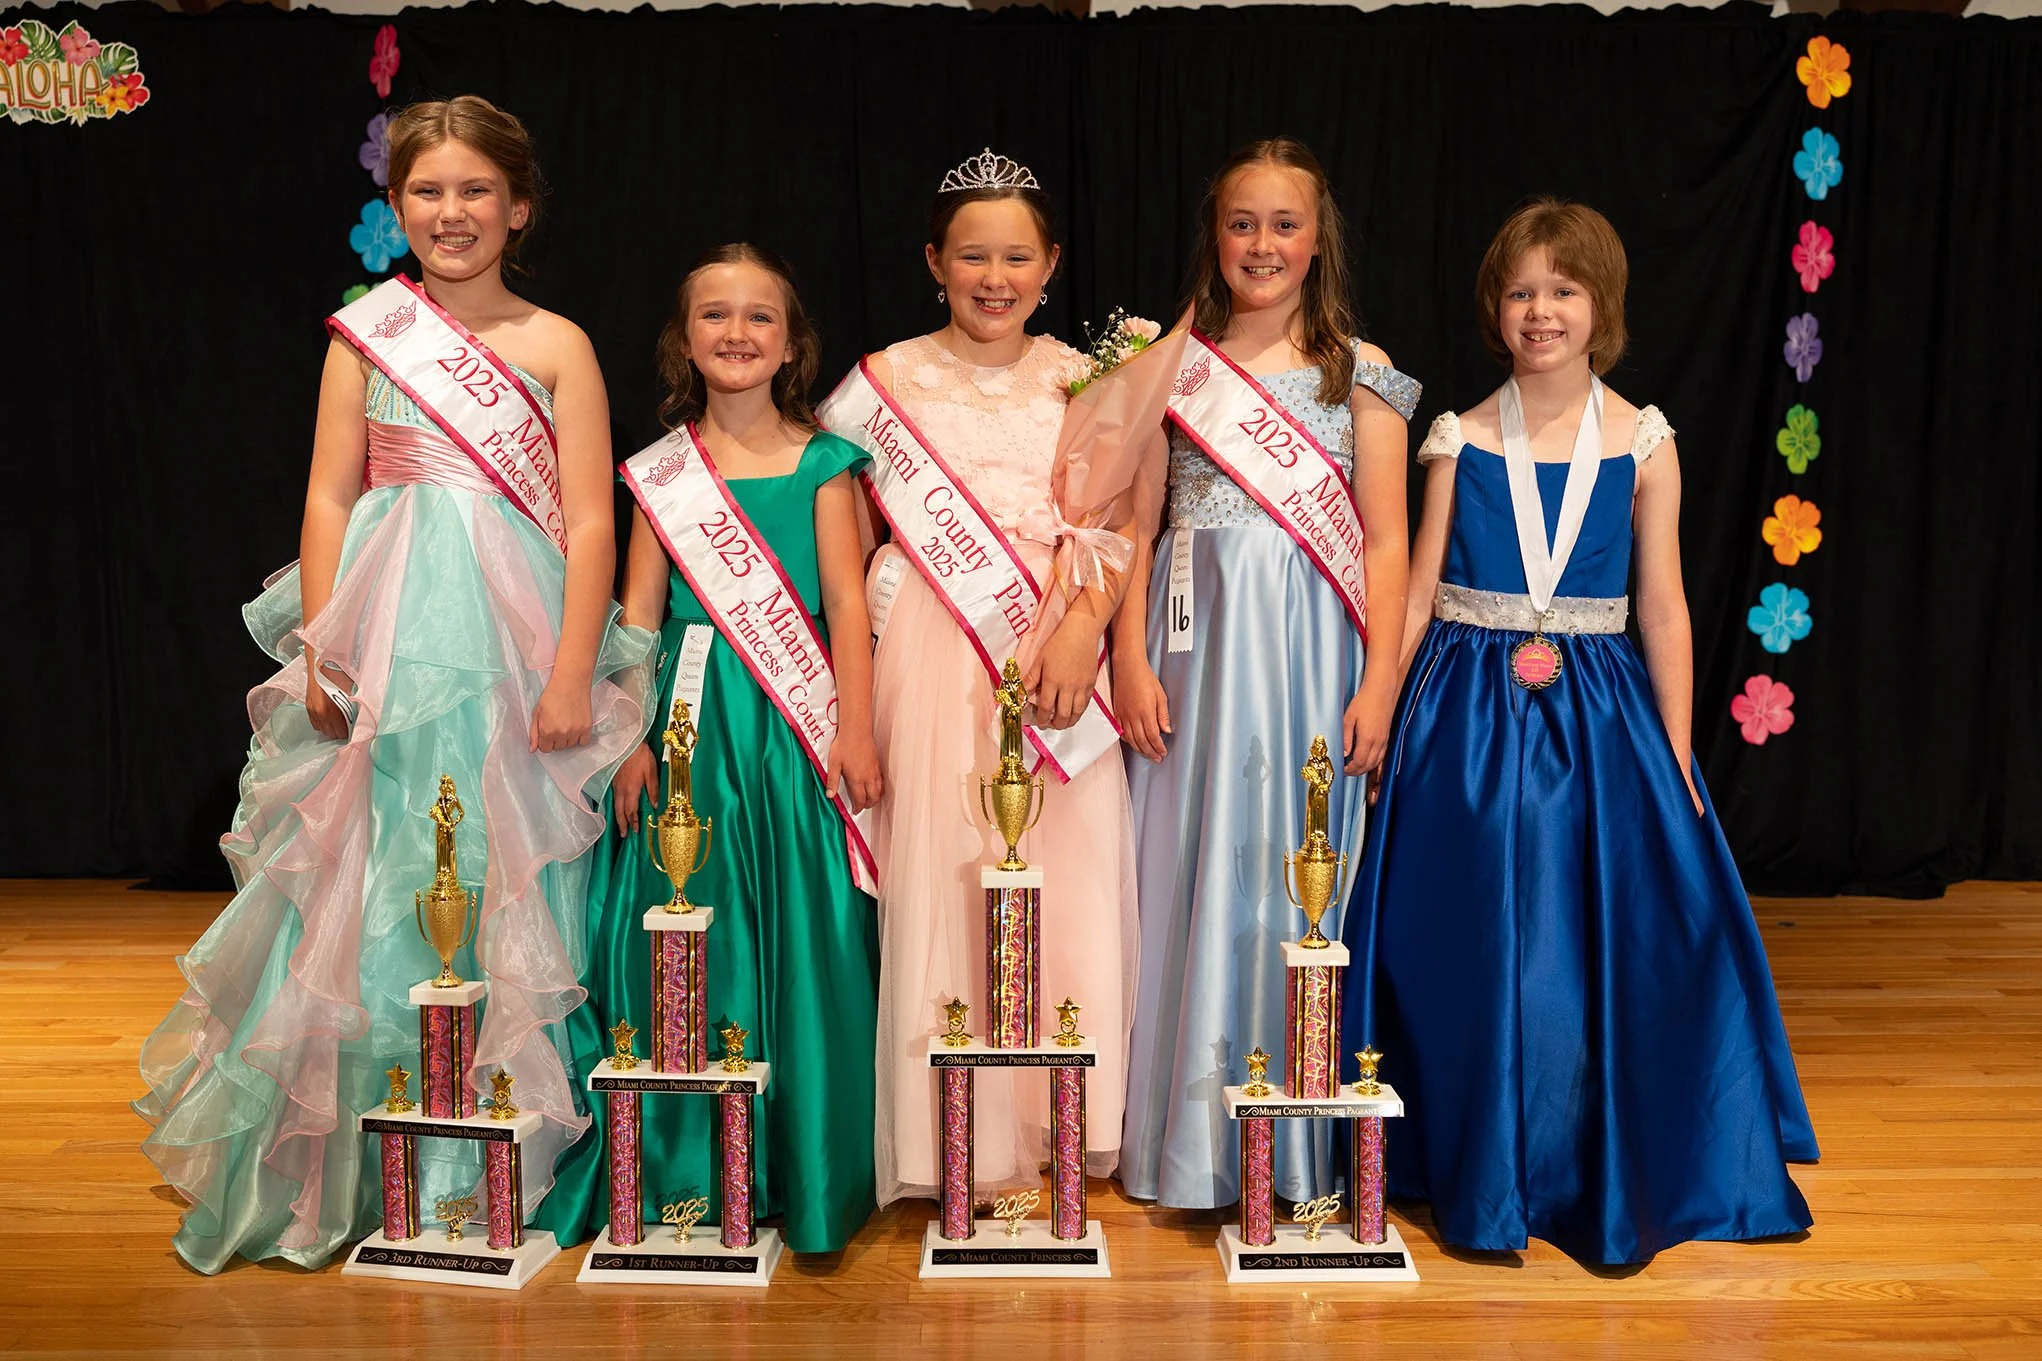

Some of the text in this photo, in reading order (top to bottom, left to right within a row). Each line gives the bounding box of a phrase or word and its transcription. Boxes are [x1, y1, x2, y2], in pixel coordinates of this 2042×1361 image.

[0, 59, 110, 110] ALOHA
[437, 346, 511, 408] 2025
[1238, 407, 1307, 469] 2025
[480, 429, 568, 558] Princess Cou
[862, 404, 1034, 639] Miami County Prin
[920, 536, 959, 578] 2025
[1280, 489, 1367, 617] Princess Cour
[698, 511, 826, 686] 2025 Miami
[1172, 594, 1190, 633] 16
[727, 599, 826, 744] Princess Court
[662, 1196, 709, 1223] 2025
[993, 1189, 1040, 1219] 2025
[1293, 1193, 1340, 1222] 2025
